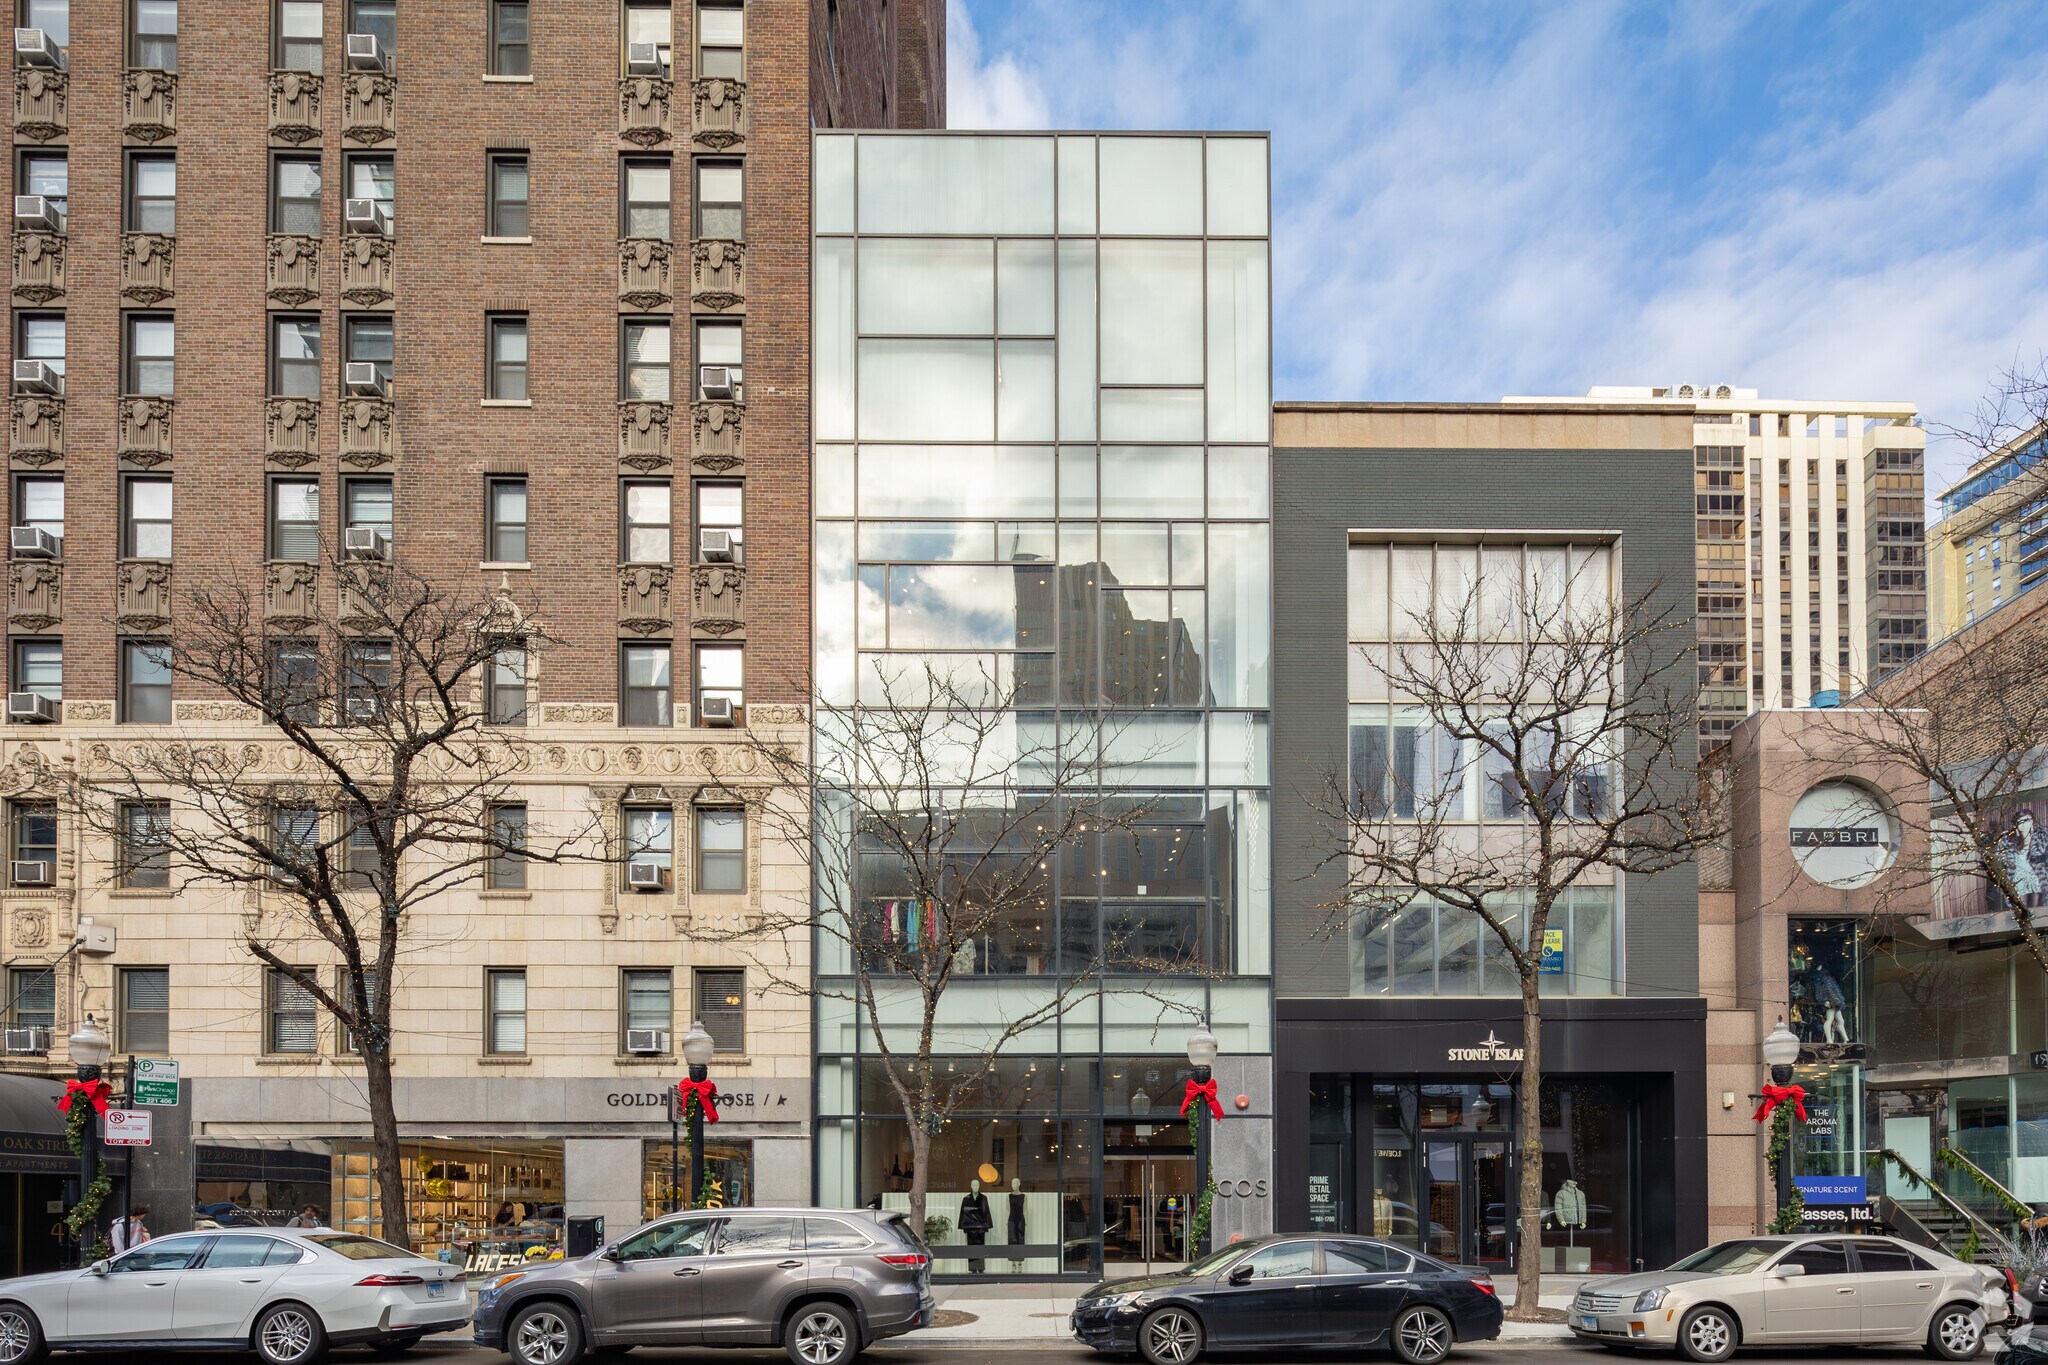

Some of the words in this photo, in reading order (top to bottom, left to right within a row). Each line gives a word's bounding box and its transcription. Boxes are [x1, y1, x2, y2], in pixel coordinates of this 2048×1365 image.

[1792, 831, 1877, 843] FABBRI
[1448, 1048, 1490, 1061] STONE
[1494, 1048, 1524, 1061] ISLA
[607, 1093, 668, 1107] GOLDE
[1813, 1109, 1829, 1117] THE
[1806, 1118, 1837, 1126] AROMA
[3, 1137, 33, 1150] OAK
[1309, 1175, 1329, 1184] PRIME
[1217, 1179, 1268, 1198] COS
[1309, 1184, 1331, 1193] RETAIL
[1797, 1186, 1832, 1194] GNATURE
[1833, 1186, 1858, 1194] SCENT
[1309, 1193, 1330, 1203] SPACE
[1801, 1207, 1848, 1222] lasses,
[1851, 1207, 1874, 1220] ltd.
